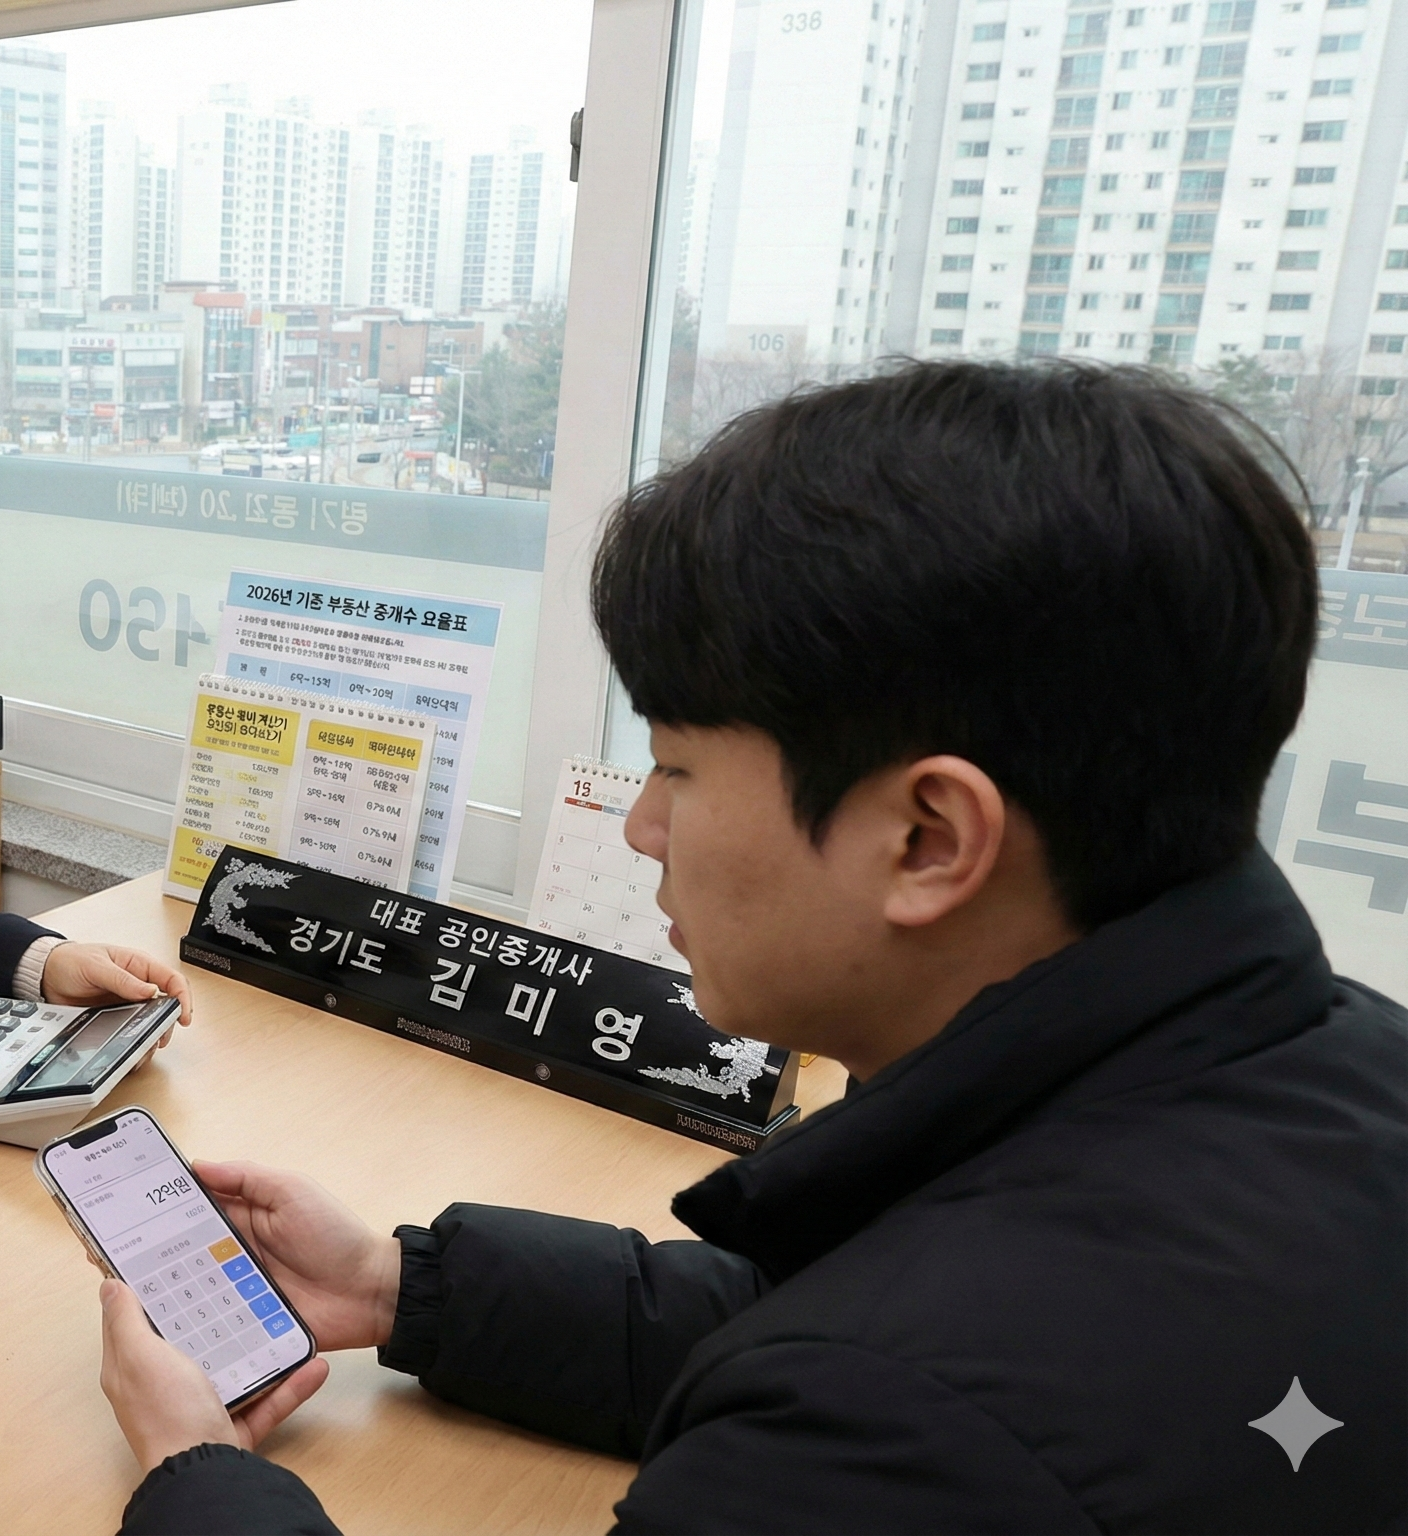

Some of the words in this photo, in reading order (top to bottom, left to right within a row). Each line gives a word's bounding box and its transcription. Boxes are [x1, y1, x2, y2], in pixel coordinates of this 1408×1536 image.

[747, 333, 785, 353] 106
[246, 585, 292, 606] 2026년
[327, 595, 370, 618] 부동산
[421, 611, 468, 632] 요율표
[290, 916, 388, 974] 경기도
[369, 899, 427, 935] 대표
[438, 917, 594, 986] 공인중개사
